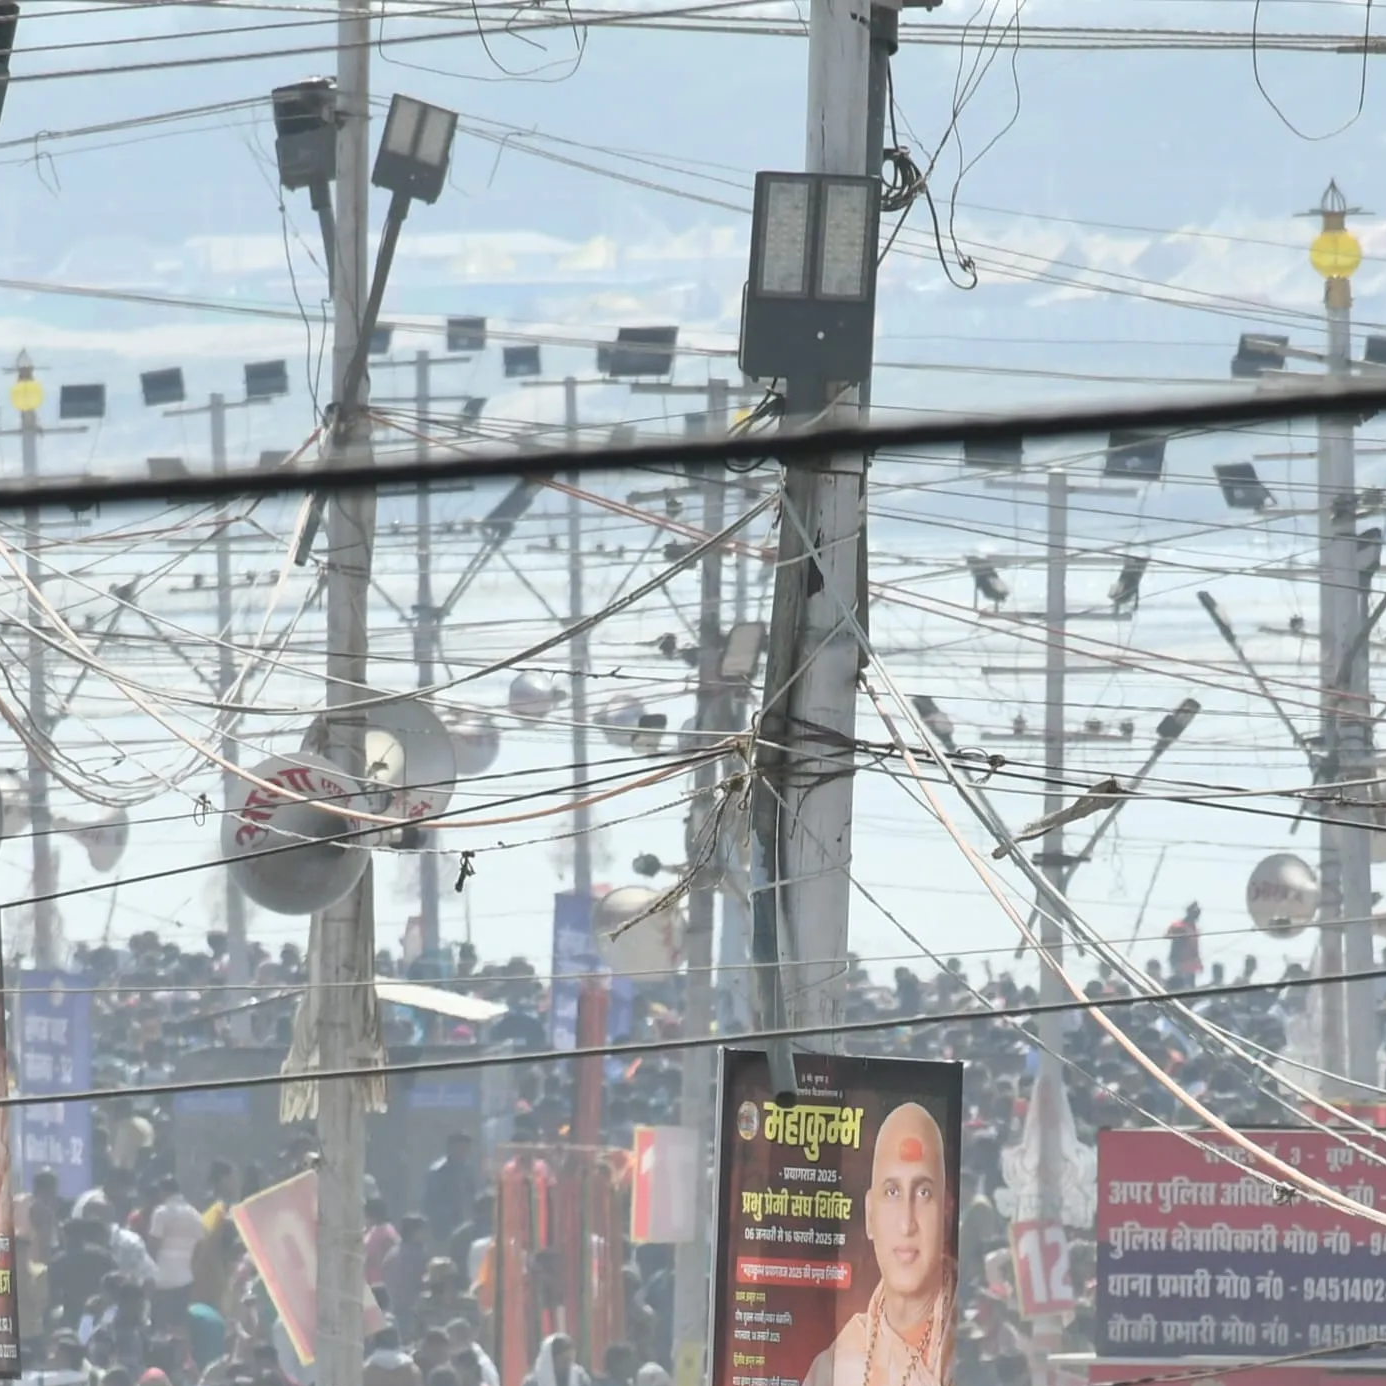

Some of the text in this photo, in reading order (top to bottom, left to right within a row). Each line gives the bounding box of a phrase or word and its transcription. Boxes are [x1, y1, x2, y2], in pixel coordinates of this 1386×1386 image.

[763, 1101, 864, 1161] महाकुम्भ
[783, 1167, 837, 1183] प्रयागराज 2025
[742, 1187, 852, 1222] प्रभु प्रेमी संघ शिविर
[1109, 1182, 1154, 1205] अपर
[1158, 1180, 1214, 1212] पुलिस
[745, 1227, 754, 1240] 06
[755, 1226, 776, 1241] जनवरी
[784, 1230, 792, 1243] 16
[793, 1228, 814, 1244] फरवरी
[815, 1232, 832, 1245] 2025
[1109, 1224, 1167, 1259] पुलिस
[1171, 1222, 1277, 1253] क्षेत्राधिकारी
[1019, 1227, 1074, 1303] 12
[1157, 1268, 1210, 1299] प्रभारी
[1163, 1316, 1215, 1345] प्रभारी
